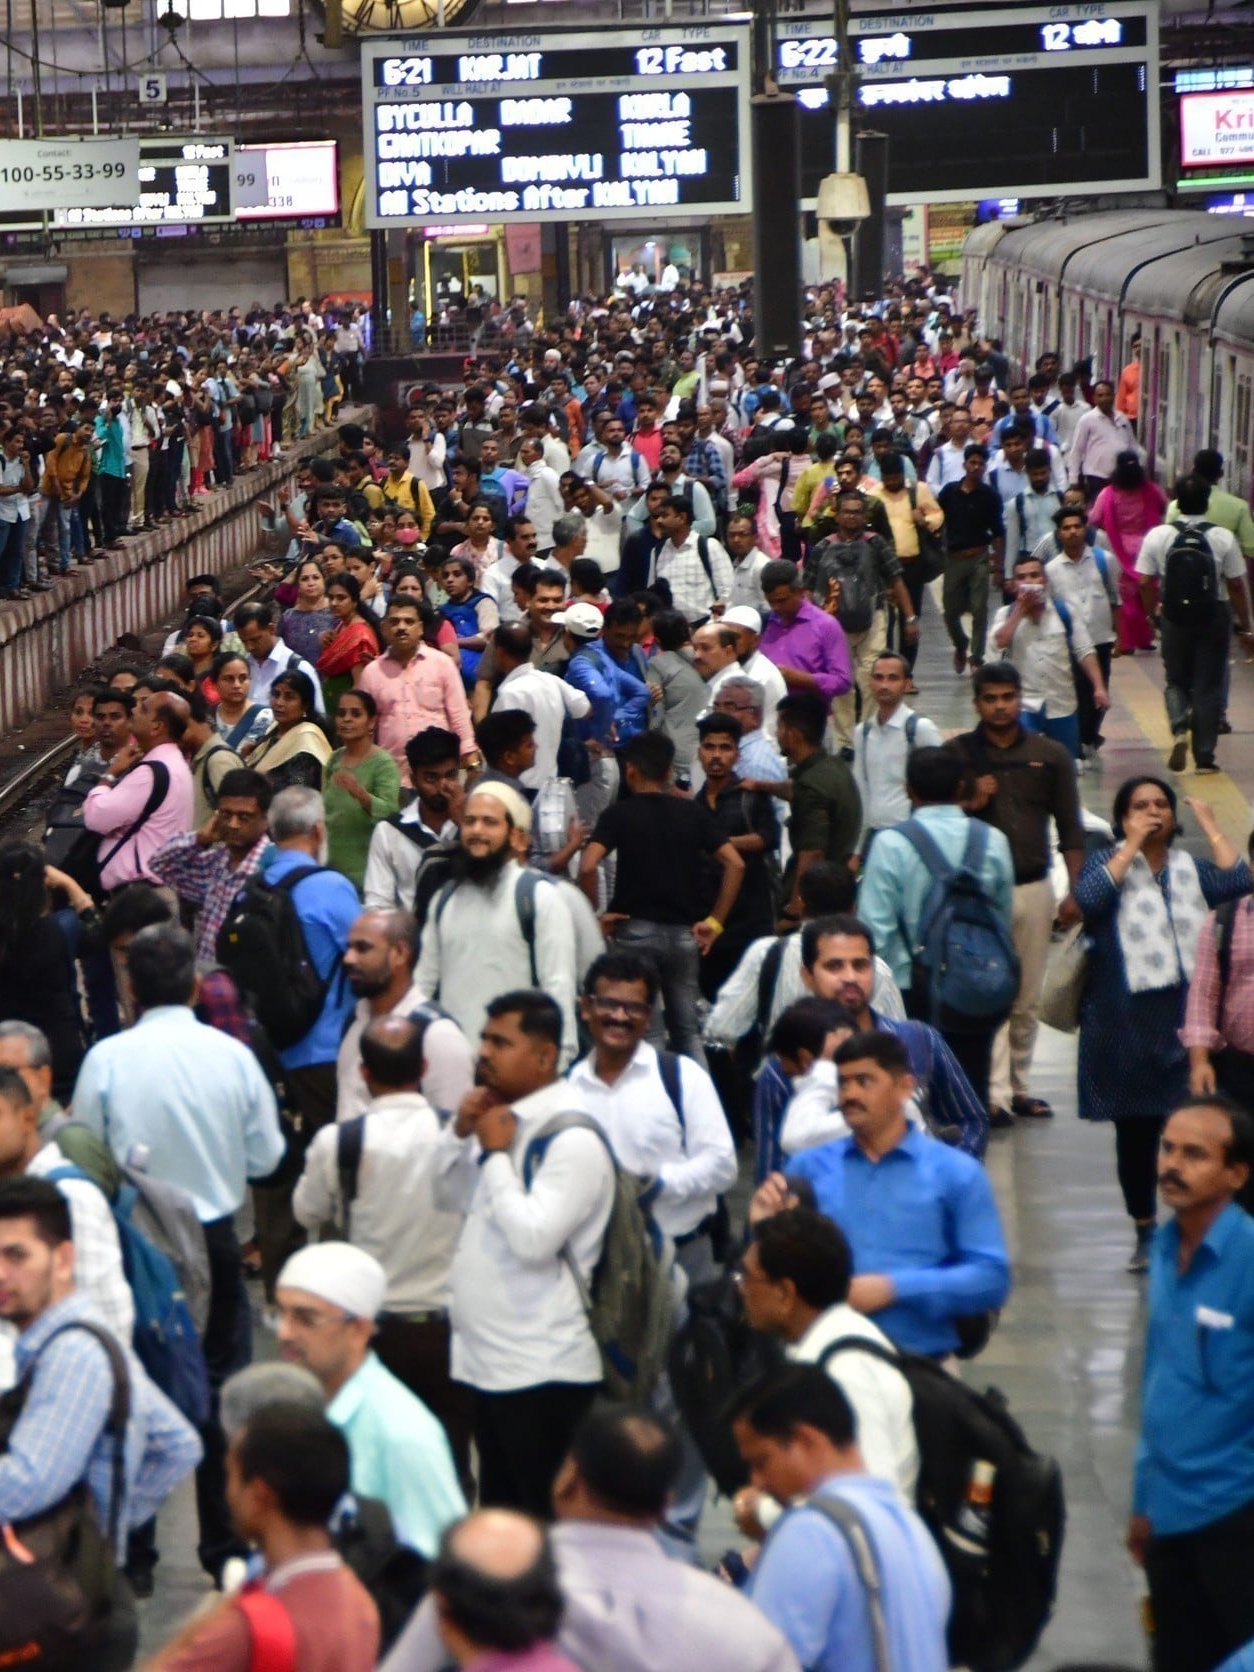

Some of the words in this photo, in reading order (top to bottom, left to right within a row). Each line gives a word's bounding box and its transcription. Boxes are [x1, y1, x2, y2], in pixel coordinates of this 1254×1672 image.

[1049, 7, 1069, 18] CAR
[1076, 5, 1106, 16] TYPE
[784, 22, 812, 35] TIME
[859, 16, 935, 30] DESTINATION
[642, 29, 661, 41] CAR
[681, 27, 711, 39] TYPE
[1042, 23, 1070, 50] 12
[401, 39, 429, 51] TIME
[467, 36, 542, 49] DESTINATION
[636, 47, 664, 74] 12
[665, 46, 726, 73] Fast
[893, 62, 906, 73] AT
[145, 79, 161, 98] 5
[411, 86, 421, 97] 5
[490, 82, 502, 92] AT
[411, 186, 520, 215] Stations
